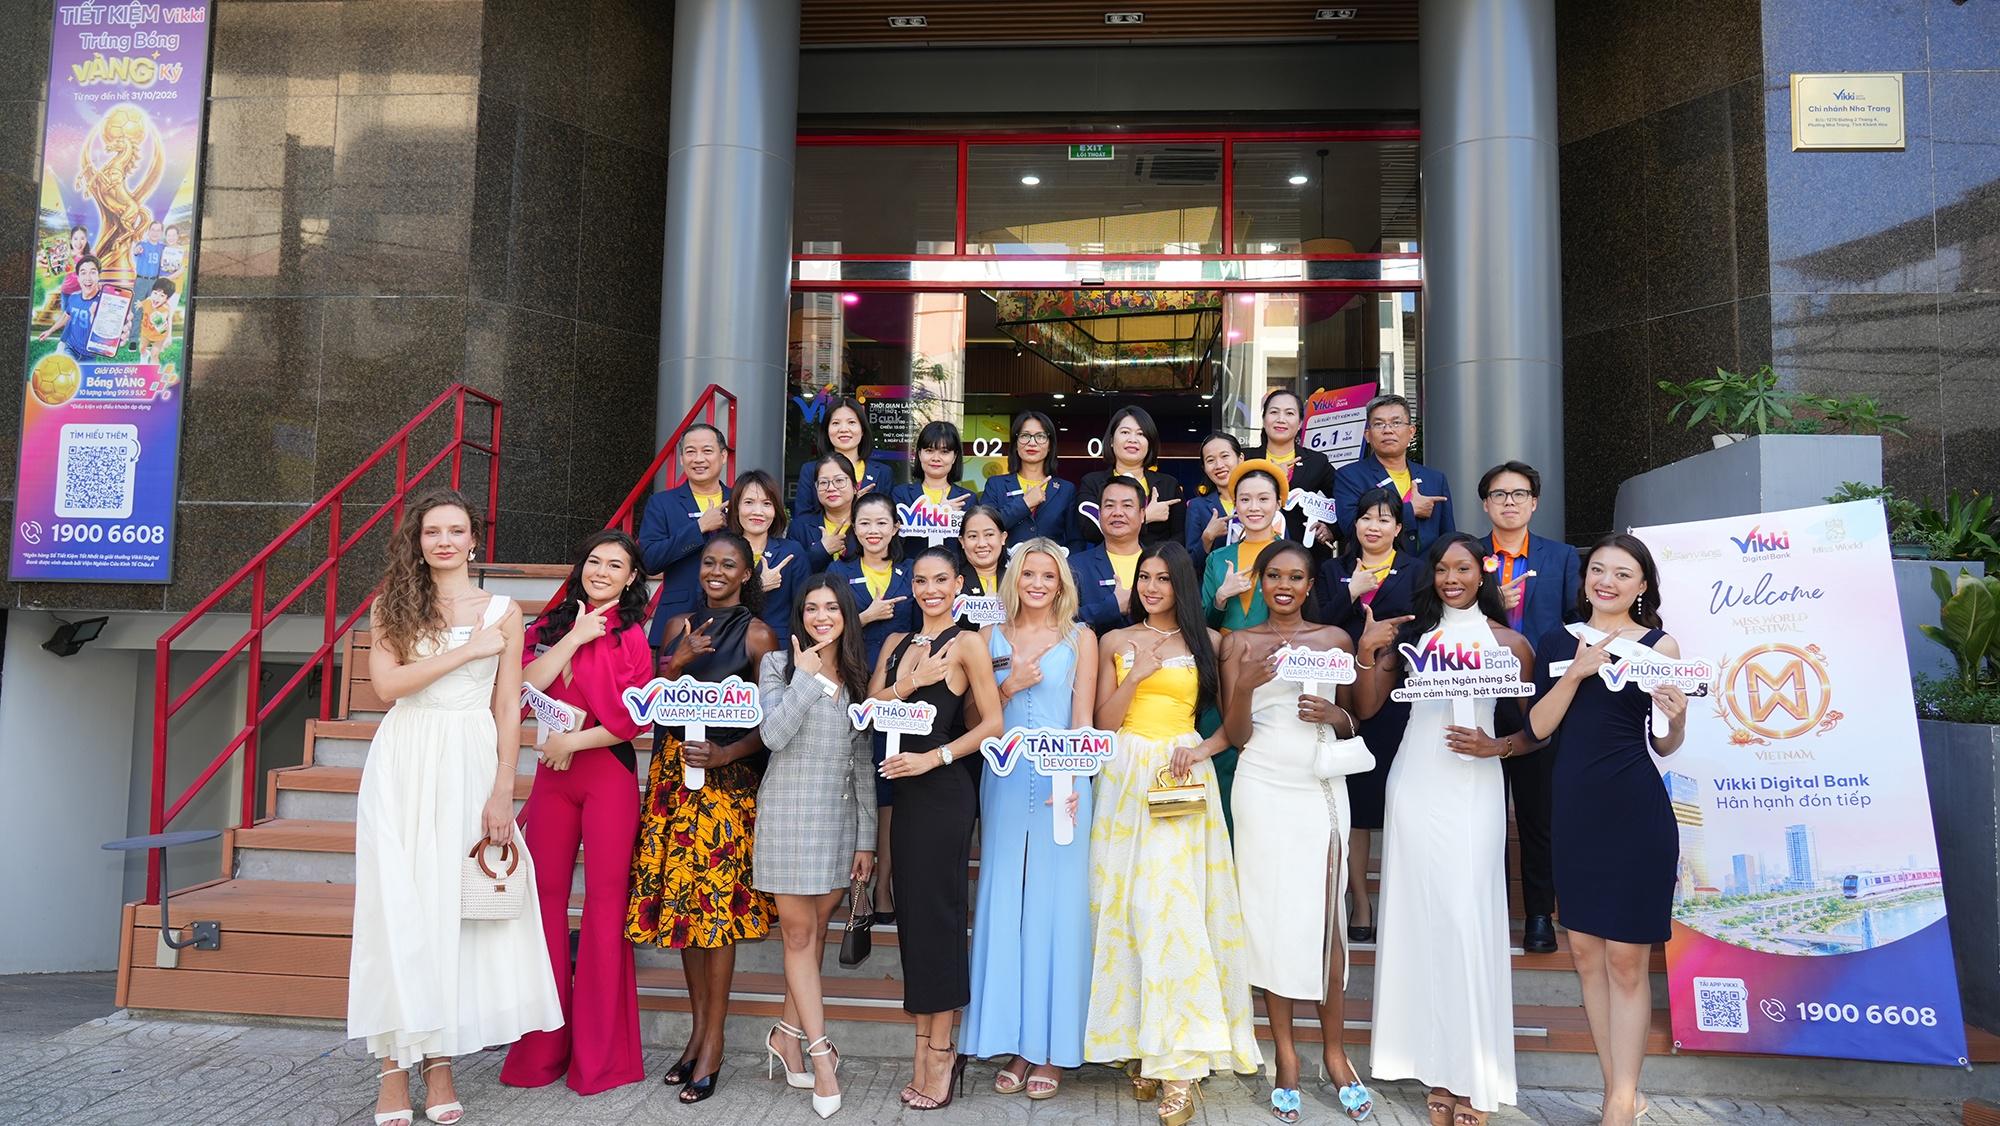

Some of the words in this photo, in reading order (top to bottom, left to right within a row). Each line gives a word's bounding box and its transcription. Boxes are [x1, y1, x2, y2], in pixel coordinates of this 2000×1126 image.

[60, 0, 107, 25] TIẾT
[108, 1, 160, 28] KIỆM
[163, 6, 205, 24] Vikki
[79, 31, 130, 52] Trúng
[134, 31, 180, 51] Bóng
[71, 52, 156, 85] VÀNG
[131, 91, 177, 100] 31/10/2026
[1833, 89, 1855, 100] Vikki
[148, 252, 159, 264] 19
[70, 306, 89, 329] 79
[86, 376, 113, 389] Bóng
[115, 375, 146, 387] VÀNG
[870, 413, 902, 424] Bank
[70, 430, 84, 439] TÌM
[85, 429, 104, 439] HIỂU
[106, 430, 128, 439] THÊM
[1311, 430, 1338, 448] 6.1
[973, 438, 1002, 457] 02
[1088, 438, 1103, 457] 0
[899, 498, 948, 526] Vikki
[1324, 502, 1335, 512] TÂ
[51, 523, 103, 543] 1900
[108, 524, 165, 544] 6608
[1730, 525, 1790, 554] Vikki
[1710, 572, 1824, 614] Welcome
[1732, 616, 1760, 627] MISS
[1761, 612, 1808, 624] WORLD
[1745, 623, 1805, 635] FESTIVAL
[1402, 630, 1481, 672] Vikki
[1484, 650, 1510, 660] Digital
[1329, 654, 1348, 668] ẤM
[1485, 658, 1519, 669] Bank
[1285, 669, 1350, 679] WARM-HEARTED
[1631, 662, 1671, 676] HỨNG
[1675, 663, 1709, 677] KHỞI
[1408, 678, 1432, 687] Điểm
[1433, 678, 1450, 687] hẹn
[1452, 677, 1477, 686] Ngân
[1479, 675, 1503, 685] hàng
[1505, 672, 1517, 682] Số
[663, 683, 718, 704] NỒNG
[722, 683, 752, 704] ẤM
[1394, 691, 1421, 700] Chạm
[1423, 689, 1443, 697] cảm
[1473, 687, 1490, 696] bật
[1492, 686, 1520, 695] tương
[1521, 684, 1533, 693] lai
[531, 694, 546, 710] VUI
[548, 704, 569, 725] TƯƠI
[660, 708, 755, 720] WARM-HEARTED
[876, 705, 906, 717] THÁO
[879, 720, 926, 729] RESOURCEFUL
[1027, 734, 1064, 760] TẬN
[1067, 733, 1110, 753] TÂM
[1755, 749, 1816, 761] VIETNAM
[1043, 758, 1094, 768] DEVOTED
[1714, 778, 1756, 791] Vikki
[1761, 775, 1819, 792] Digital
[1824, 773, 1870, 788] Bank
[1717, 797, 1749, 809] Hân
[1753, 795, 1794, 811] hạnh
[1799, 794, 1832, 807] đón
[1836, 790, 1871, 808] tiếp
[1797, 1001, 1859, 1024] 1900
[1866, 1003, 1938, 1027] 6608
